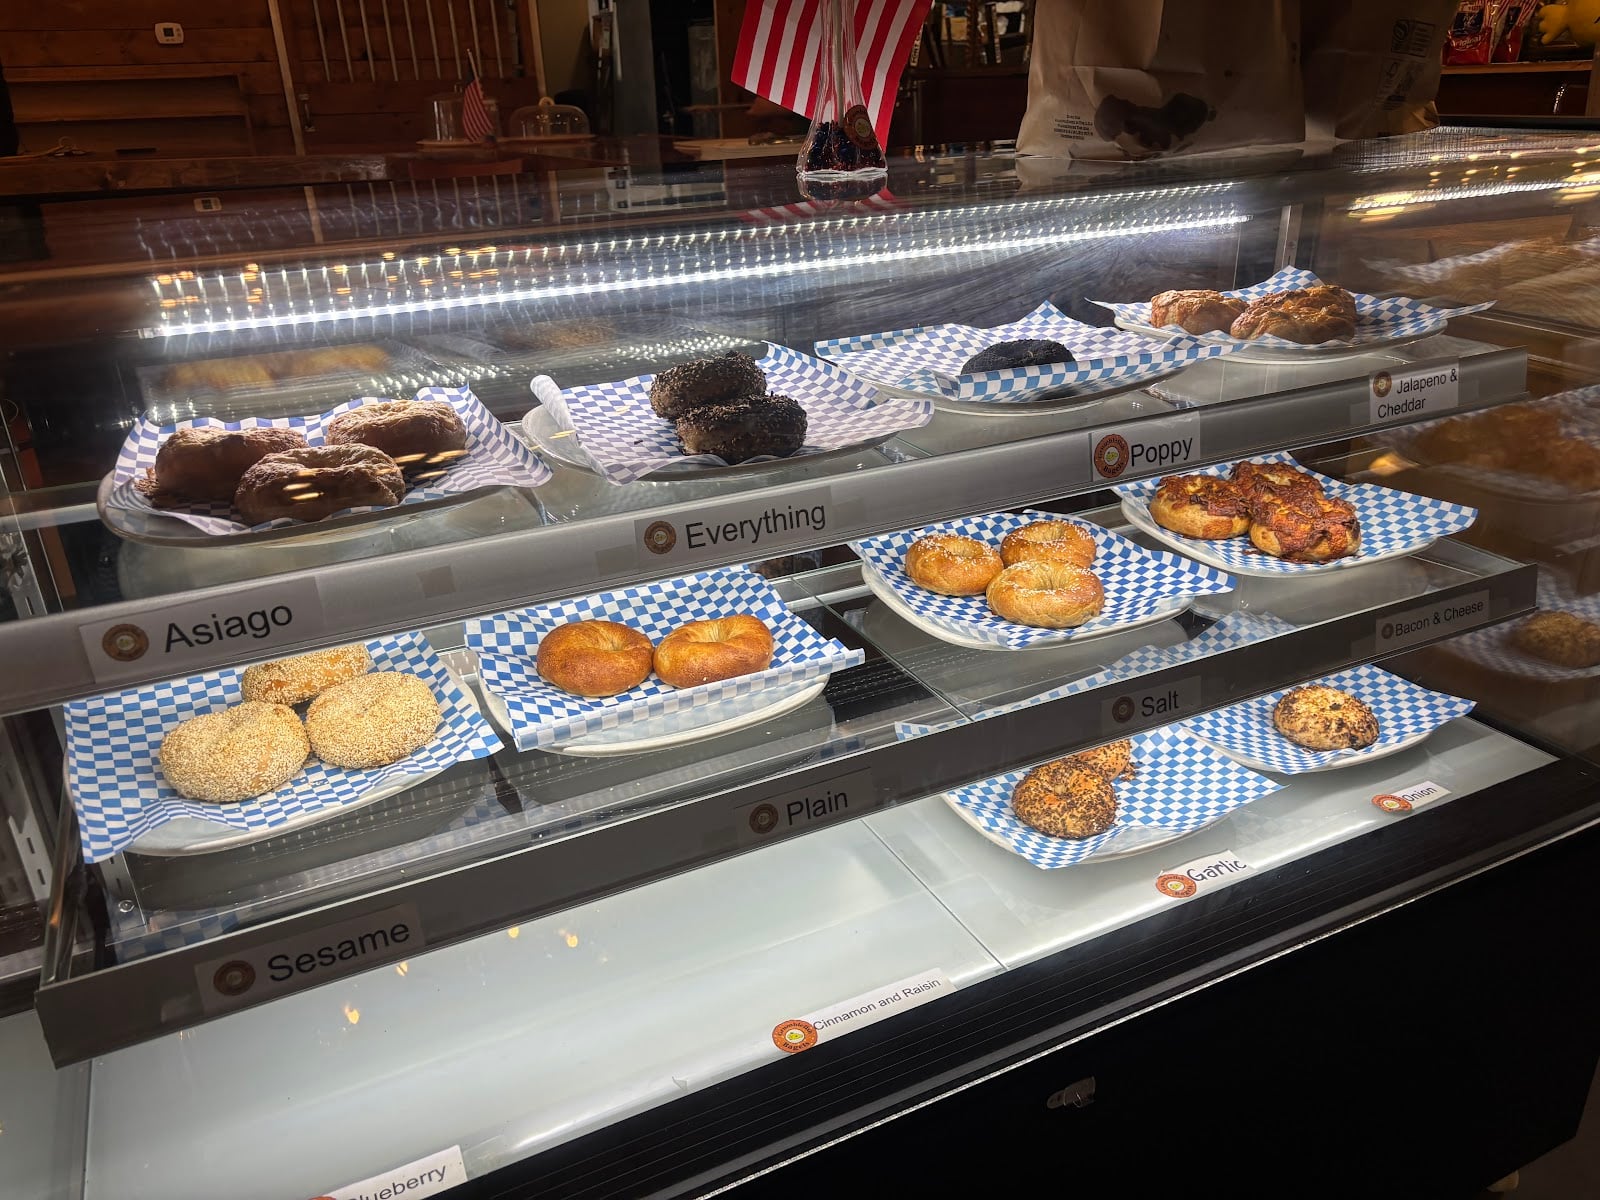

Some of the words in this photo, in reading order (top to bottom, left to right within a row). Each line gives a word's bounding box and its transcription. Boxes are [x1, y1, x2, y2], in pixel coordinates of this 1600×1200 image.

[1397, 374, 1447, 394] Jalapeno
[1450, 368, 1458, 382] &
[1377, 397, 1426, 419] Cheddar
[1130, 437, 1193, 467] Poppy
[685, 504, 826, 549] Everything
[165, 605, 293, 653] Asiago
[1395, 617, 1430, 637] Bacon
[1433, 611, 1441, 625] &
[1443, 601, 1484, 622] Cheese
[1141, 690, 1179, 717] Salt
[786, 790, 848, 826] Plain
[1401, 787, 1438, 802] Onion
[1186, 860, 1247, 882] Garlic
[267, 922, 410, 982] Sesame
[813, 1002, 877, 1031] Cinnamon
[878, 992, 902, 1007] and
[902, 978, 941, 998] Raisin
[348, 1165, 446, 1200] ueberry
